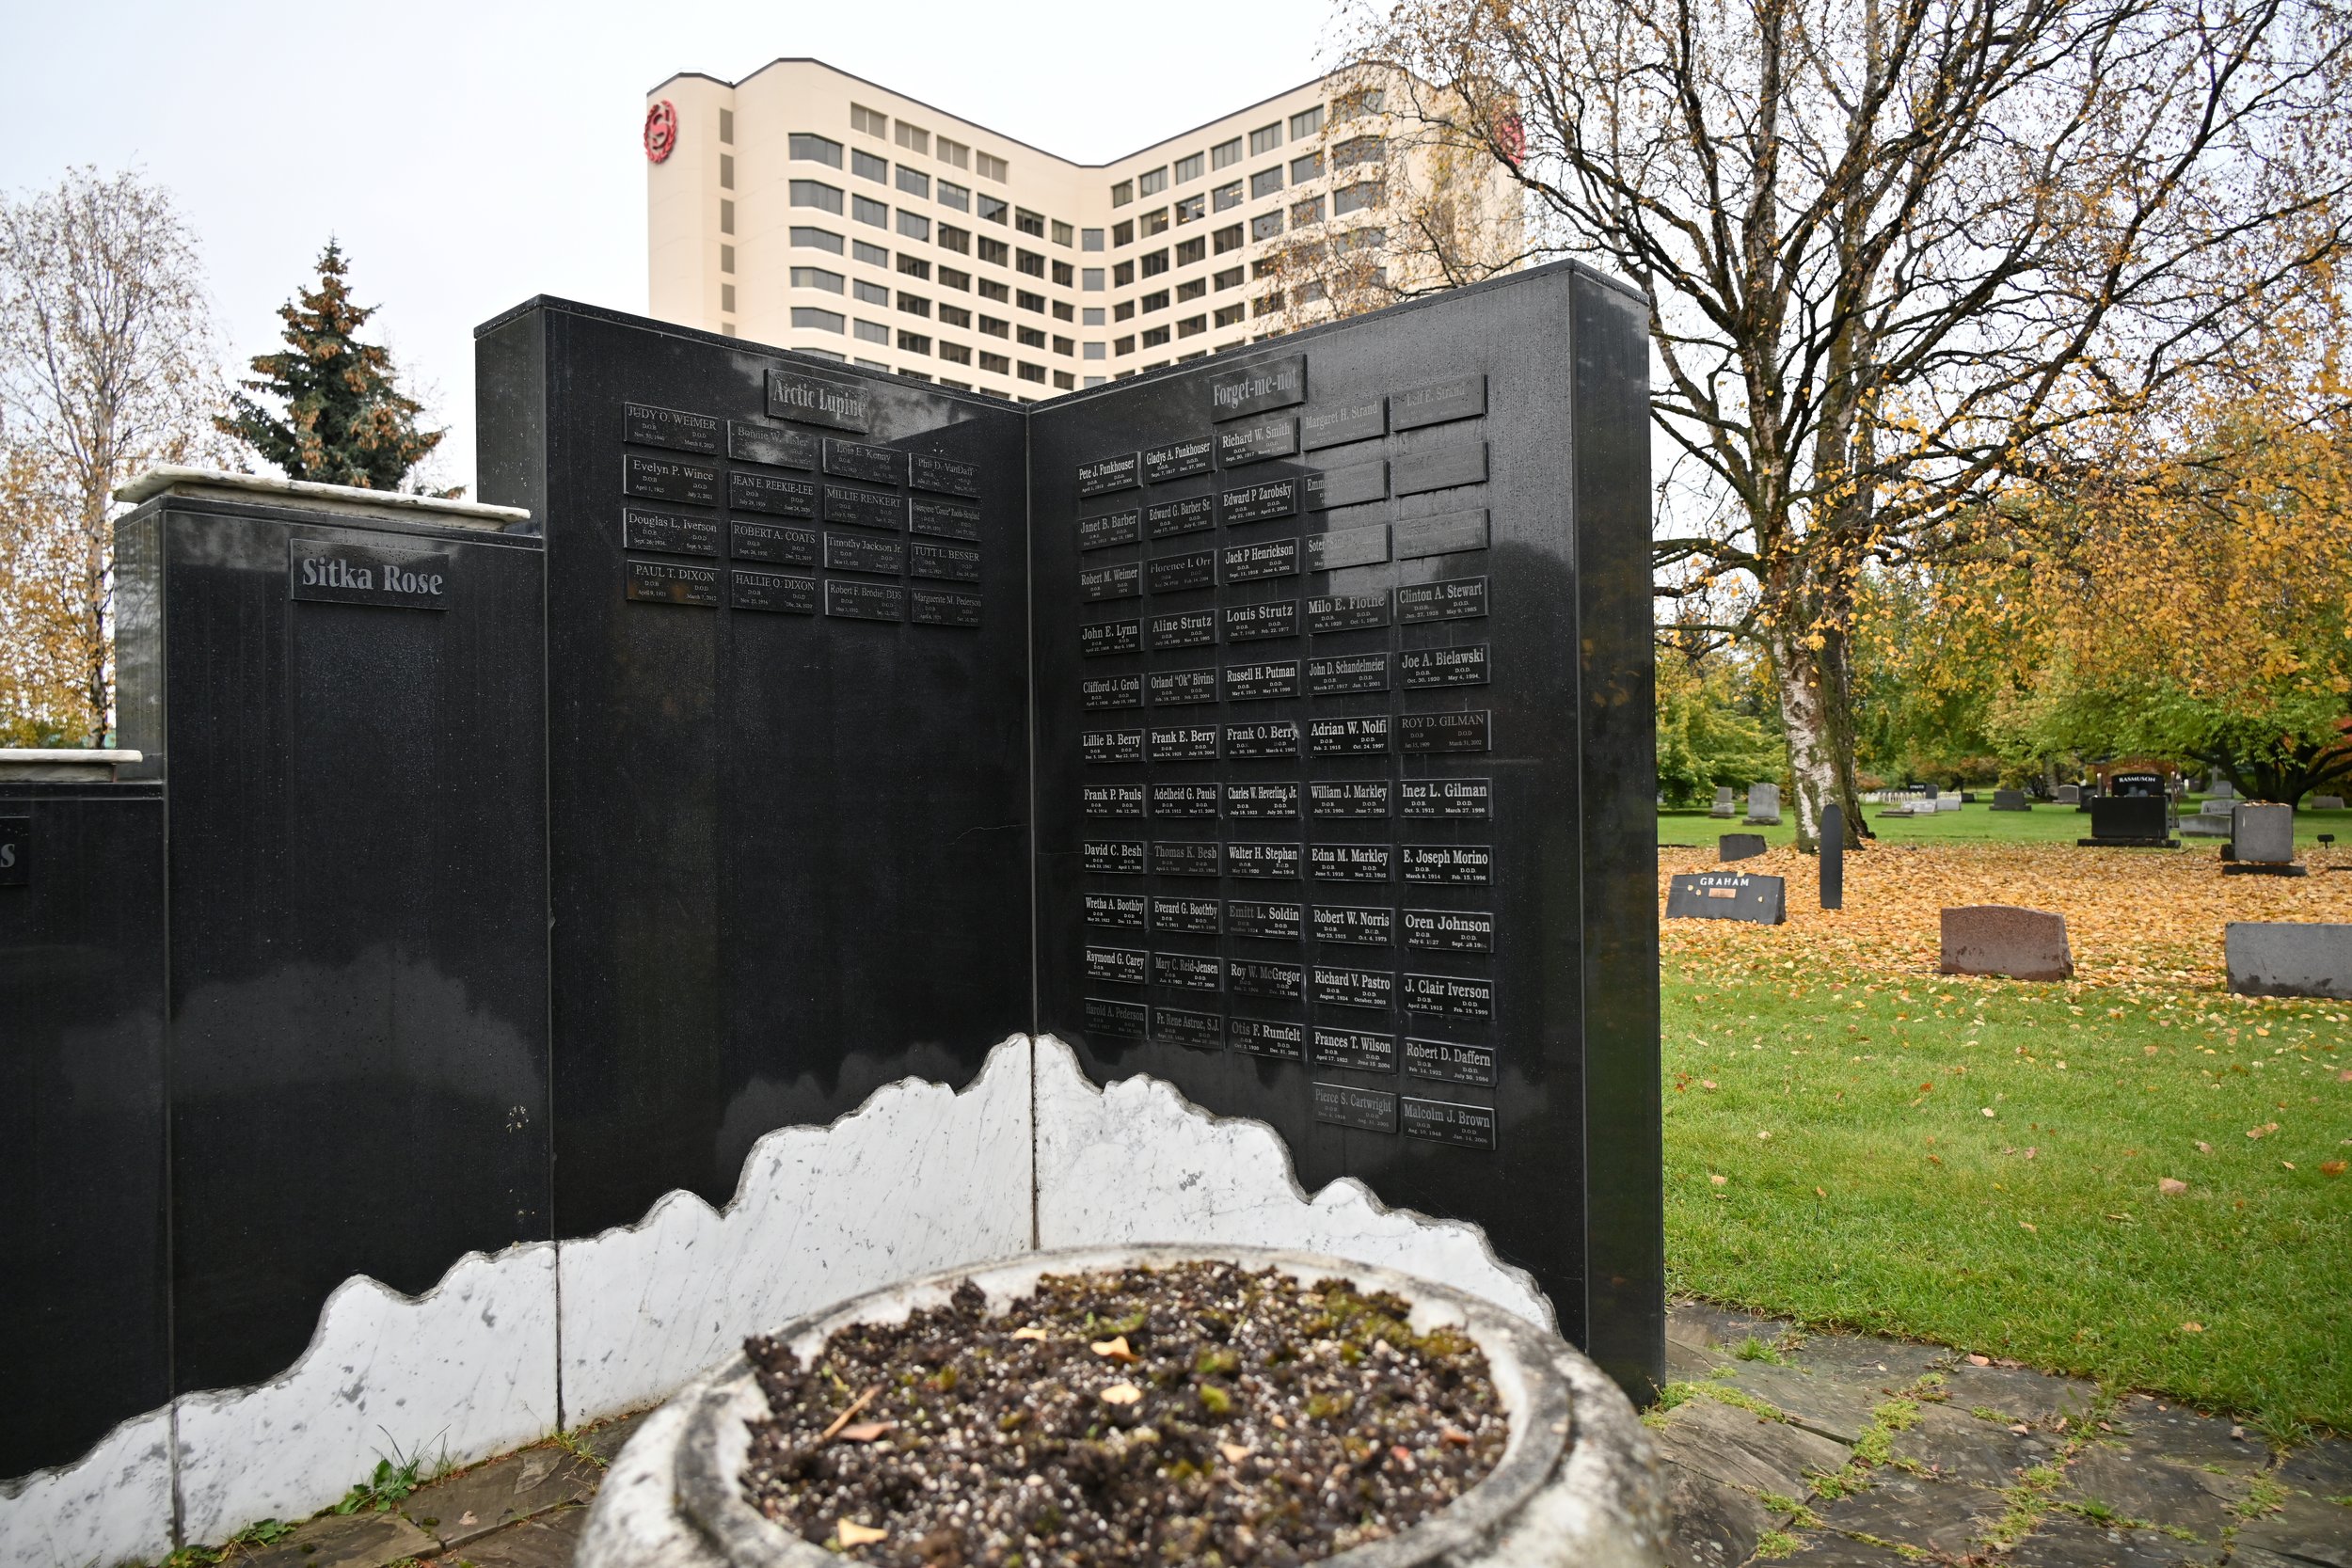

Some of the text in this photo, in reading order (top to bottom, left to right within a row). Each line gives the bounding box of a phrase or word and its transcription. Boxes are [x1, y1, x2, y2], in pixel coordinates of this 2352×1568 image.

[1214, 366, 1296, 409] Forget-me-not
[773, 379, 866, 420] Arctic Lupine
[628, 406, 716, 431] JUDY O. WEIMER
[1306, 401, 1377, 430] Margaret H. Strand
[1222, 422, 1290, 448] Richard W. Smith
[1147, 442, 1210, 466] Gladys A. Funkhouser
[633, 460, 713, 481] Evelyn P. Wince
[827, 489, 901, 507] MILLIE RENKERT
[628, 514, 717, 532] Douglas L. Iverson
[1081, 515, 1136, 533] Janet B. Barber
[734, 525, 815, 543] ROBERT A. COATS
[915, 546, 979, 562] TUTT L. BESSER
[303, 557, 442, 594] Sitka Rose
[636, 566, 714, 581] PAUL T. DIXON
[1081, 568, 1137, 585] Robert M. Weimer
[736, 575, 815, 591] HALLIE O. DIXON
[1399, 582, 1483, 603] Clinton A. Stewart
[1227, 605, 1294, 623] Louis Strutz
[1082, 625, 1137, 640] John E. Lynn
[1152, 615, 1212, 632] Aline Strutz
[1402, 648, 1485, 669] Joe A. Bielawski
[1152, 675, 1173, 689] Orland
[1193, 673, 1214, 685] Bivins
[1227, 667, 1295, 682] Russell H. Putman
[1083, 678, 1139, 693] Clifford J. Groh
[1311, 720, 1387, 736] Adrian W. Nolfi
[1402, 715, 1484, 728] ROY D. GILMAN
[1083, 734, 1141, 747] Lillie B. Berry
[1152, 730, 1216, 744] Frank E. Berry
[1084, 788, 1142, 800] Frank P. Pauls
[1154, 788, 1216, 800] Adelheid G. Pauls
[1311, 784, 1387, 801] William J. Markley
[1402, 783, 1487, 798] Inez L. Gilman
[1085, 844, 1142, 857] David C. Besh
[1229, 847, 1297, 863] Walter H. Stephan
[1311, 848, 1389, 866] Edna M. Markley
[1404, 849, 1488, 867] E. Joseph Morino
[1700, 878, 1750, 886] GRAHAM
[1313, 910, 1389, 927] Robert W. Norris
[1406, 914, 1490, 932] Oren Johnson
[1315, 971, 1391, 990] Richard V. Pastro
[1406, 979, 1490, 999] J. Clair Iverson
[1315, 1032, 1391, 1053] Frances T. Wilson
[1406, 1043, 1490, 1066] Robert D. Daffern
[1315, 1088, 1391, 1115] Pierce S. Cartwright
[1404, 1102, 1490, 1128] Malcolm J. Brown
